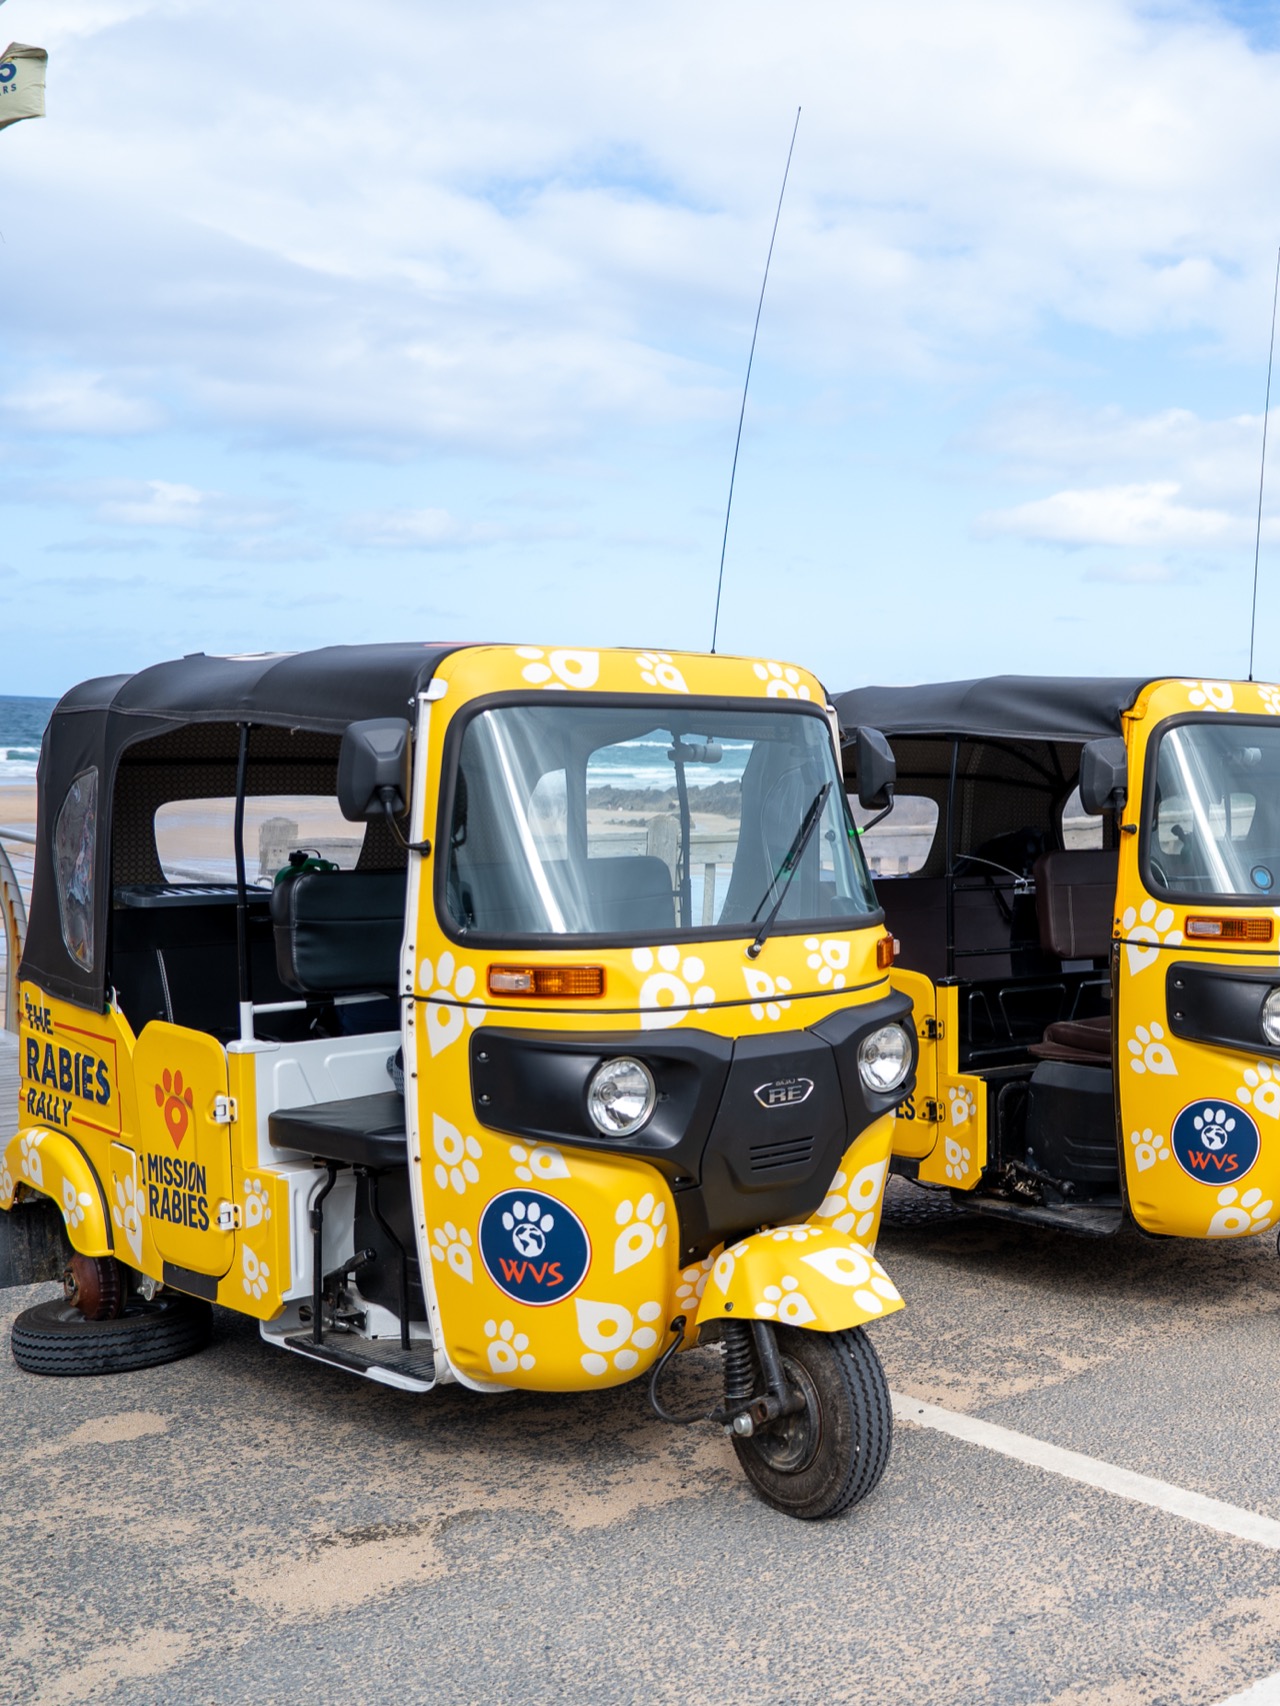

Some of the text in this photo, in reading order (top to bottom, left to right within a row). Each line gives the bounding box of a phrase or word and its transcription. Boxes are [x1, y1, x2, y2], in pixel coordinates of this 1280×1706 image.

[25, 1003, 54, 1035] THE
[27, 1037, 110, 1105] RABIES
[27, 1087, 72, 1127] RALLY
[769, 1085, 802, 1103] RE
[147, 1152, 207, 1195] MISSION
[1188, 1149, 1239, 1172] WVS
[149, 1183, 210, 1231] RABIES
[499, 1257, 564, 1287] WVS
